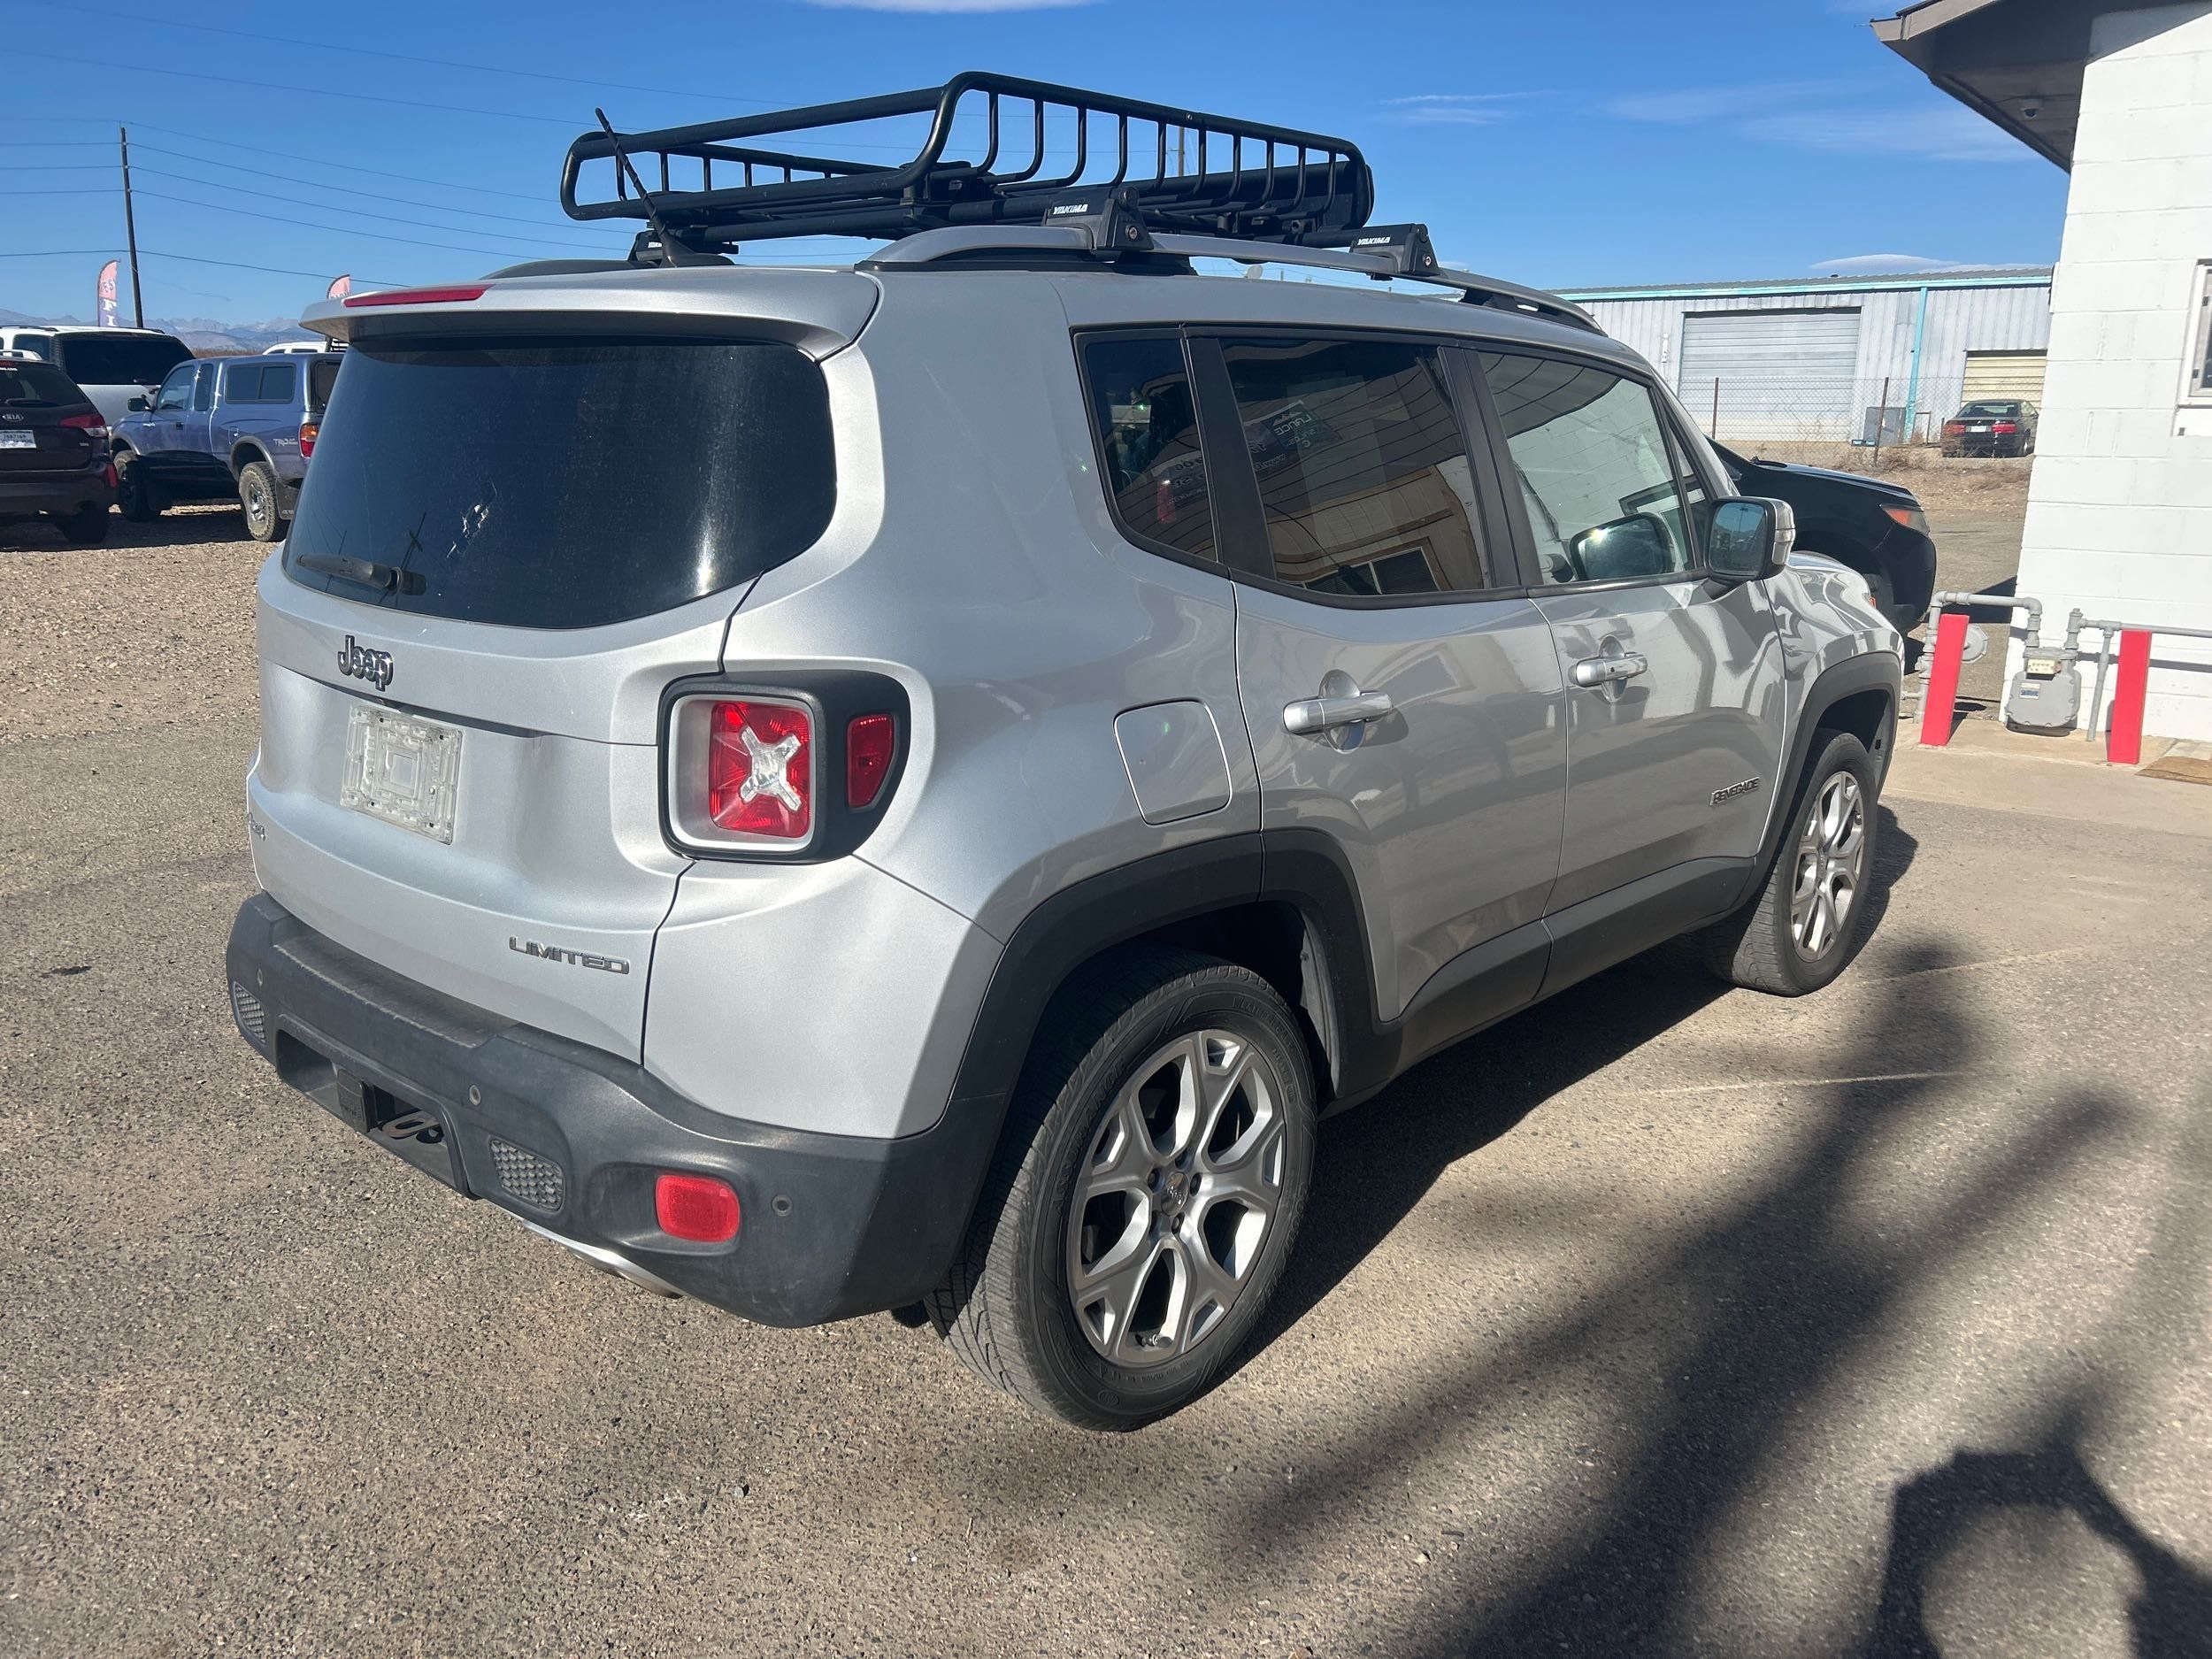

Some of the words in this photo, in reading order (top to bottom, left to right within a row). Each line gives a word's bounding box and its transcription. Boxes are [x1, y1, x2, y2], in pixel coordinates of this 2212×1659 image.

[1053, 204, 1088, 214] YAKIMA
[1356, 236, 1391, 245] YAKIMA
[337, 634, 394, 692] Jeep
[509, 936, 630, 975] LIMITED
